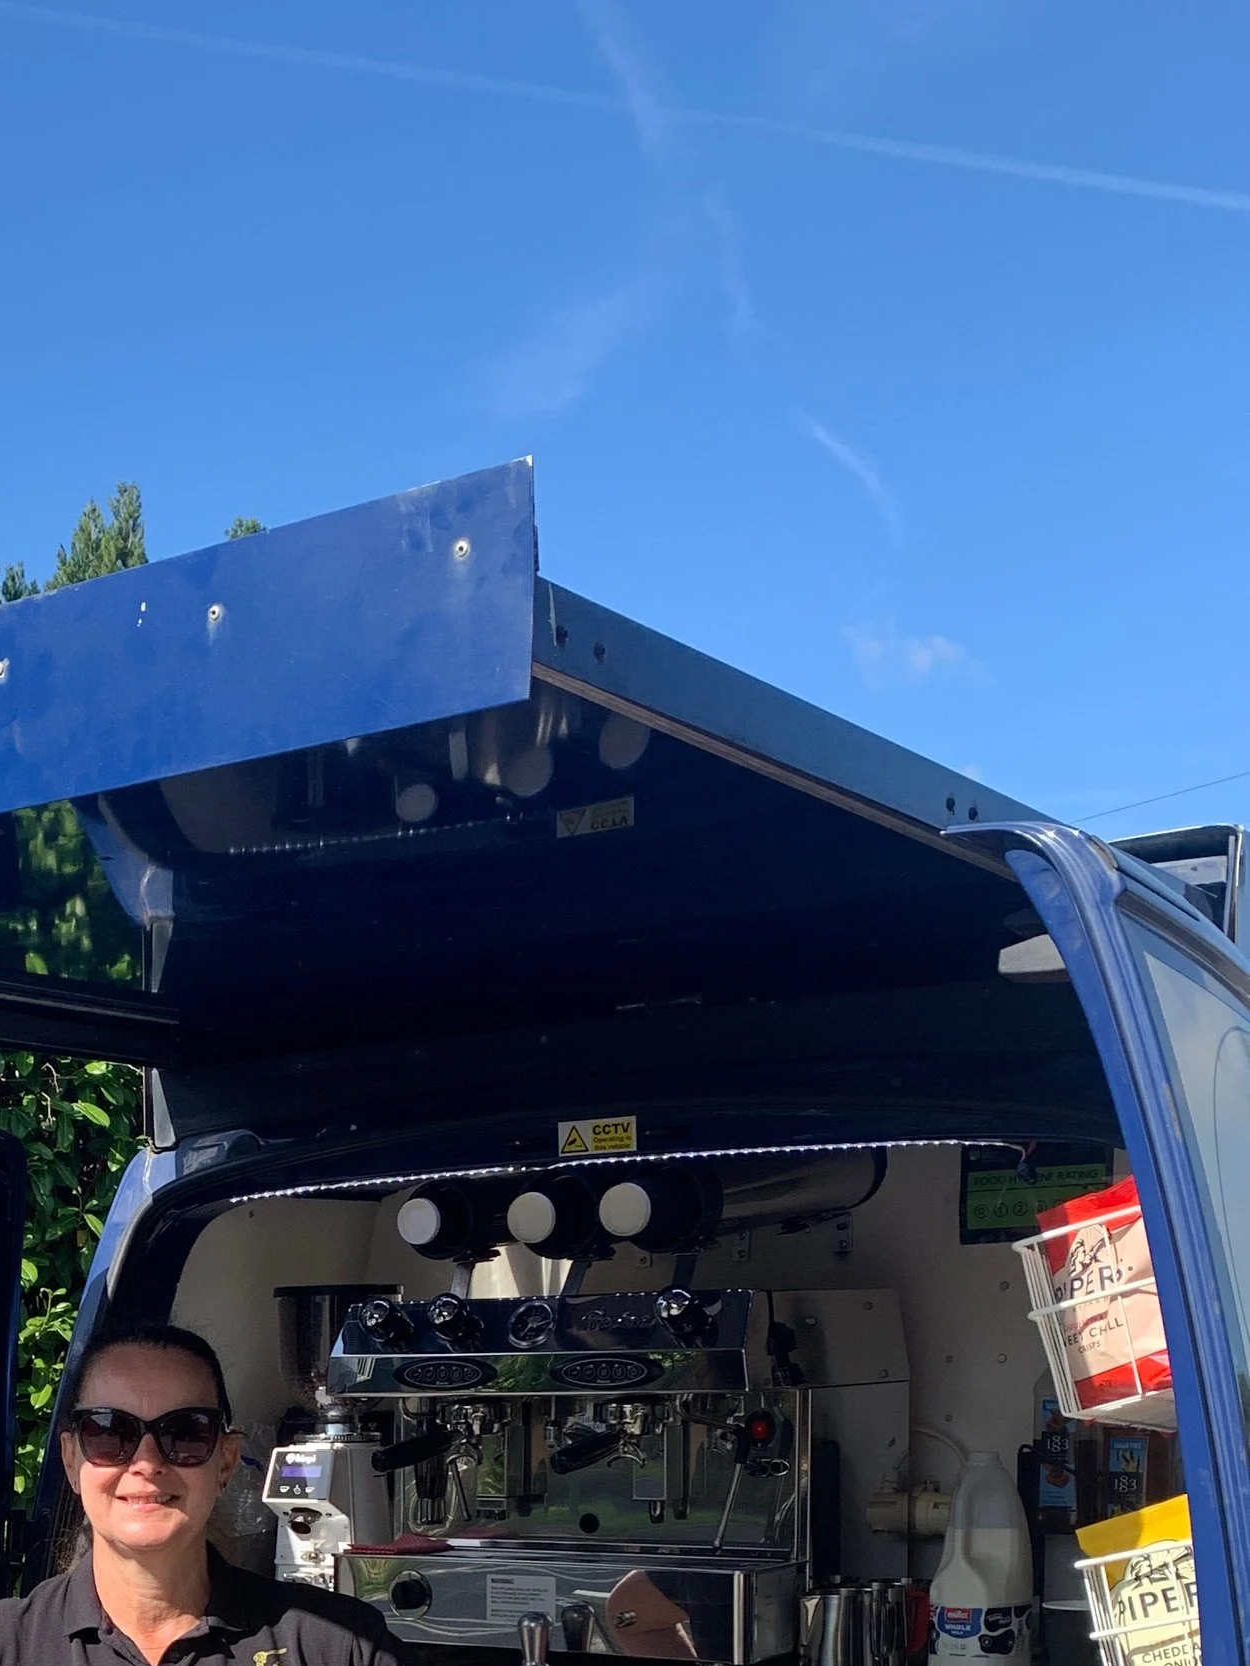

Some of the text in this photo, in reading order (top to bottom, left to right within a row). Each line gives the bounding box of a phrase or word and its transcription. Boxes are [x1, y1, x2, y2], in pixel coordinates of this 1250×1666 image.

[592, 1122, 631, 1136] CCTV
[973, 1175, 1007, 1187] FOOD
[1057, 1168, 1099, 1180] RATING
[1116, 1580, 1199, 1625] PIPER
